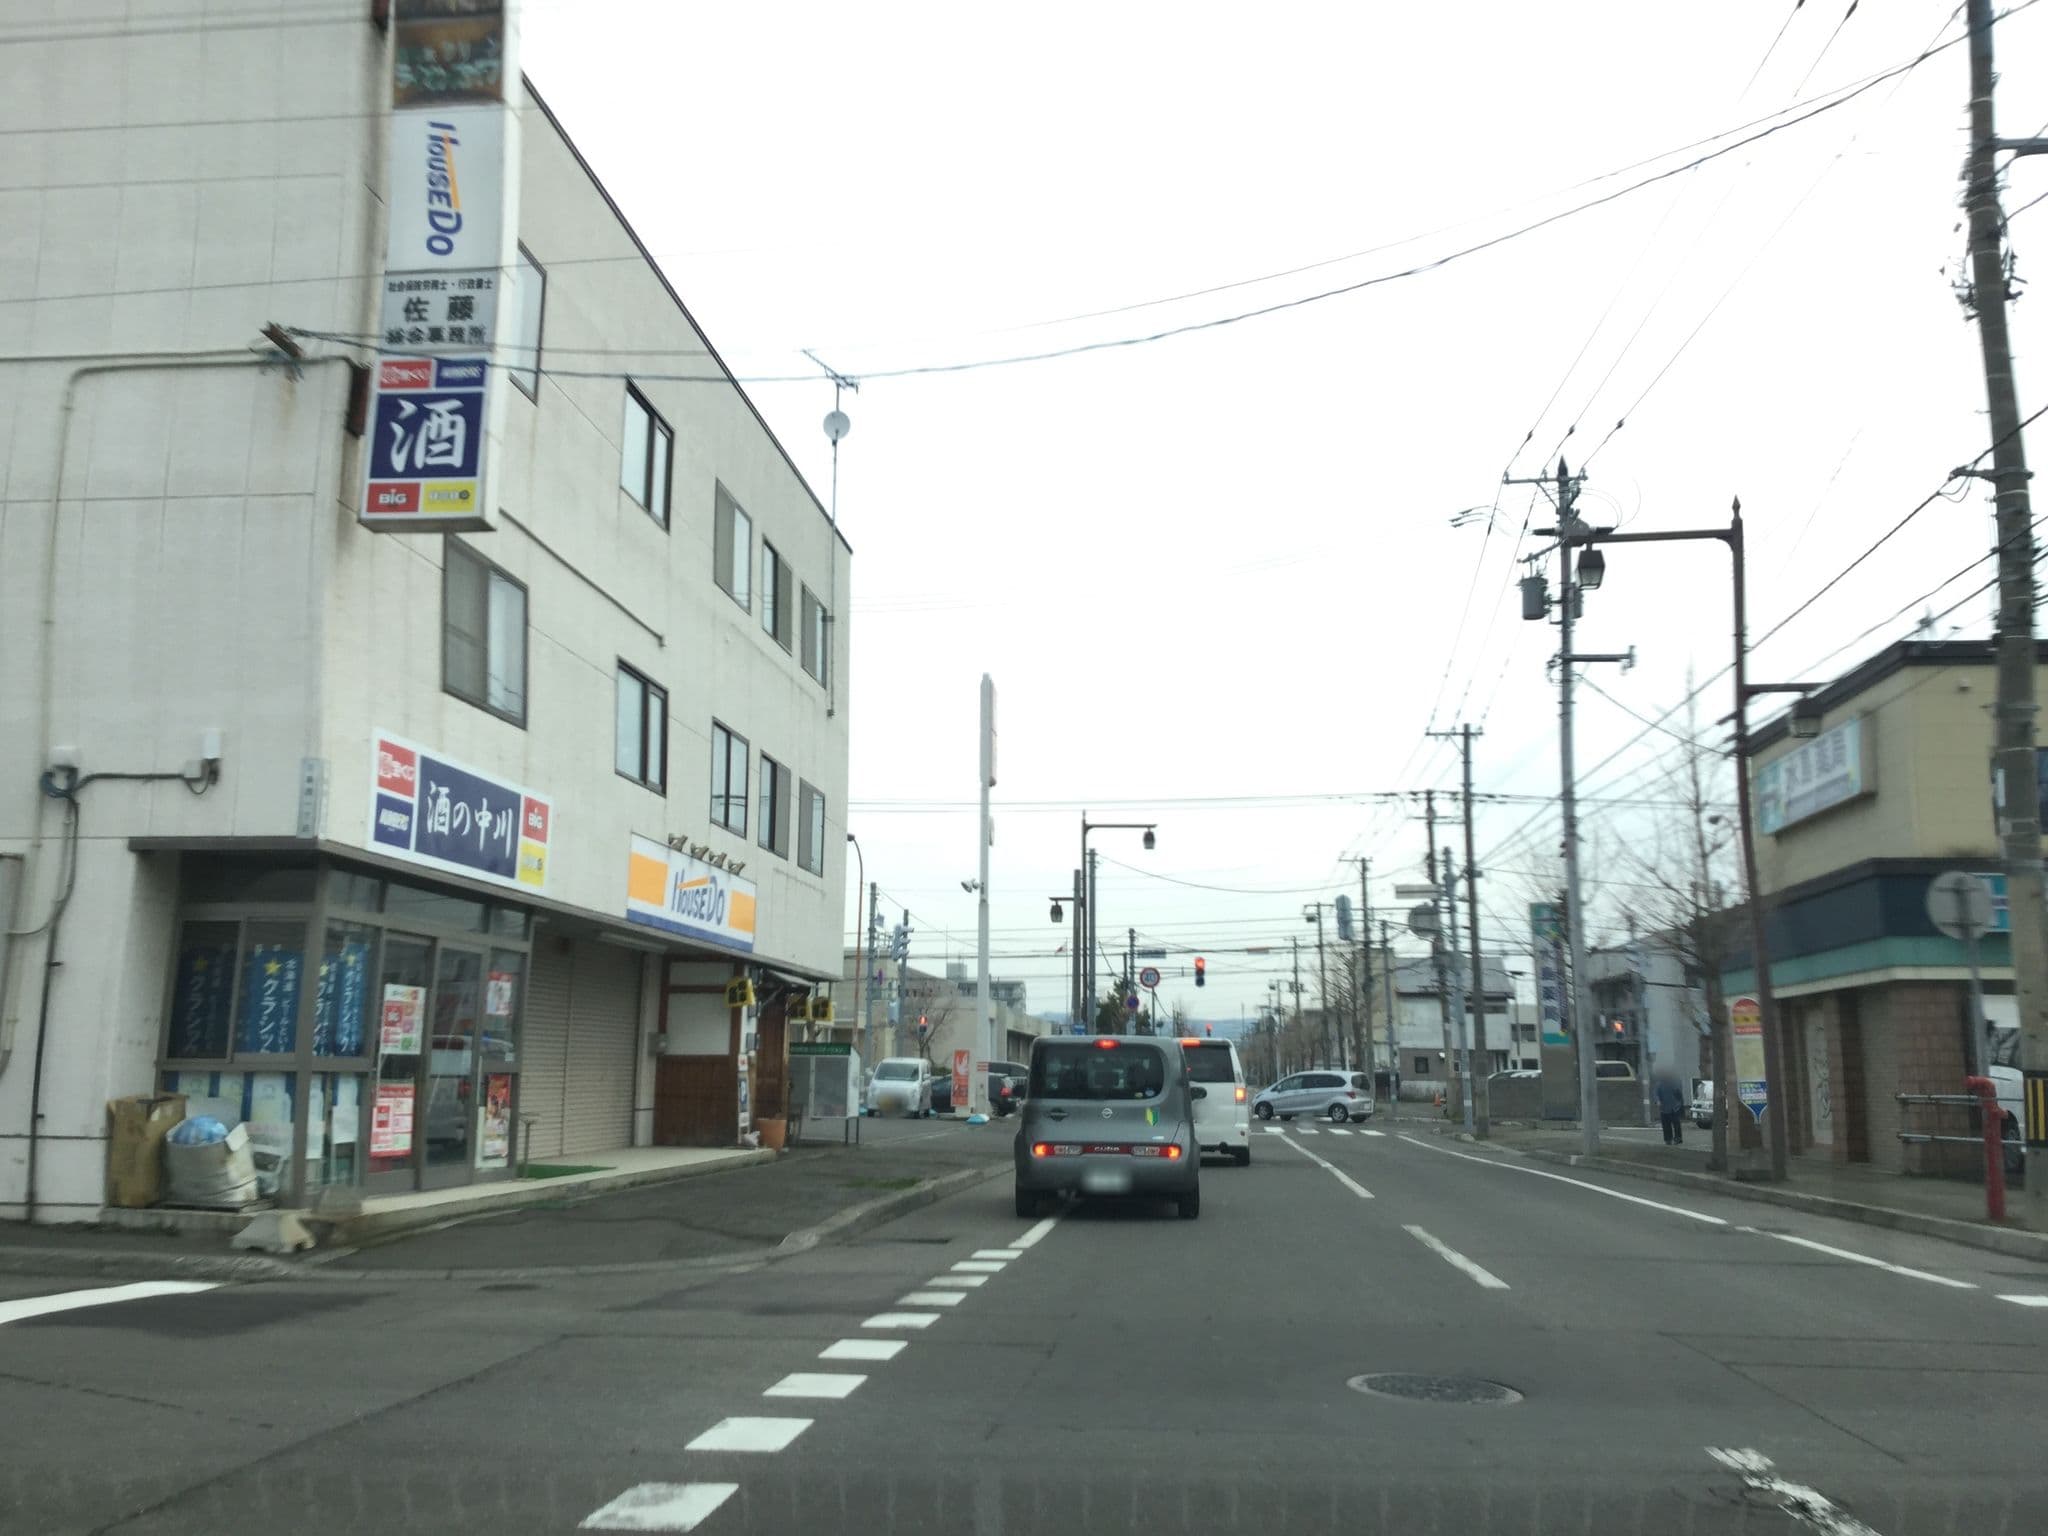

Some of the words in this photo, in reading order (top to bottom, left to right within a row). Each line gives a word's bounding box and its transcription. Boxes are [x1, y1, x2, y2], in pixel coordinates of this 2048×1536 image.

[389, 398, 466, 473] 酒
[426, 780, 513, 859] 酒の中川
